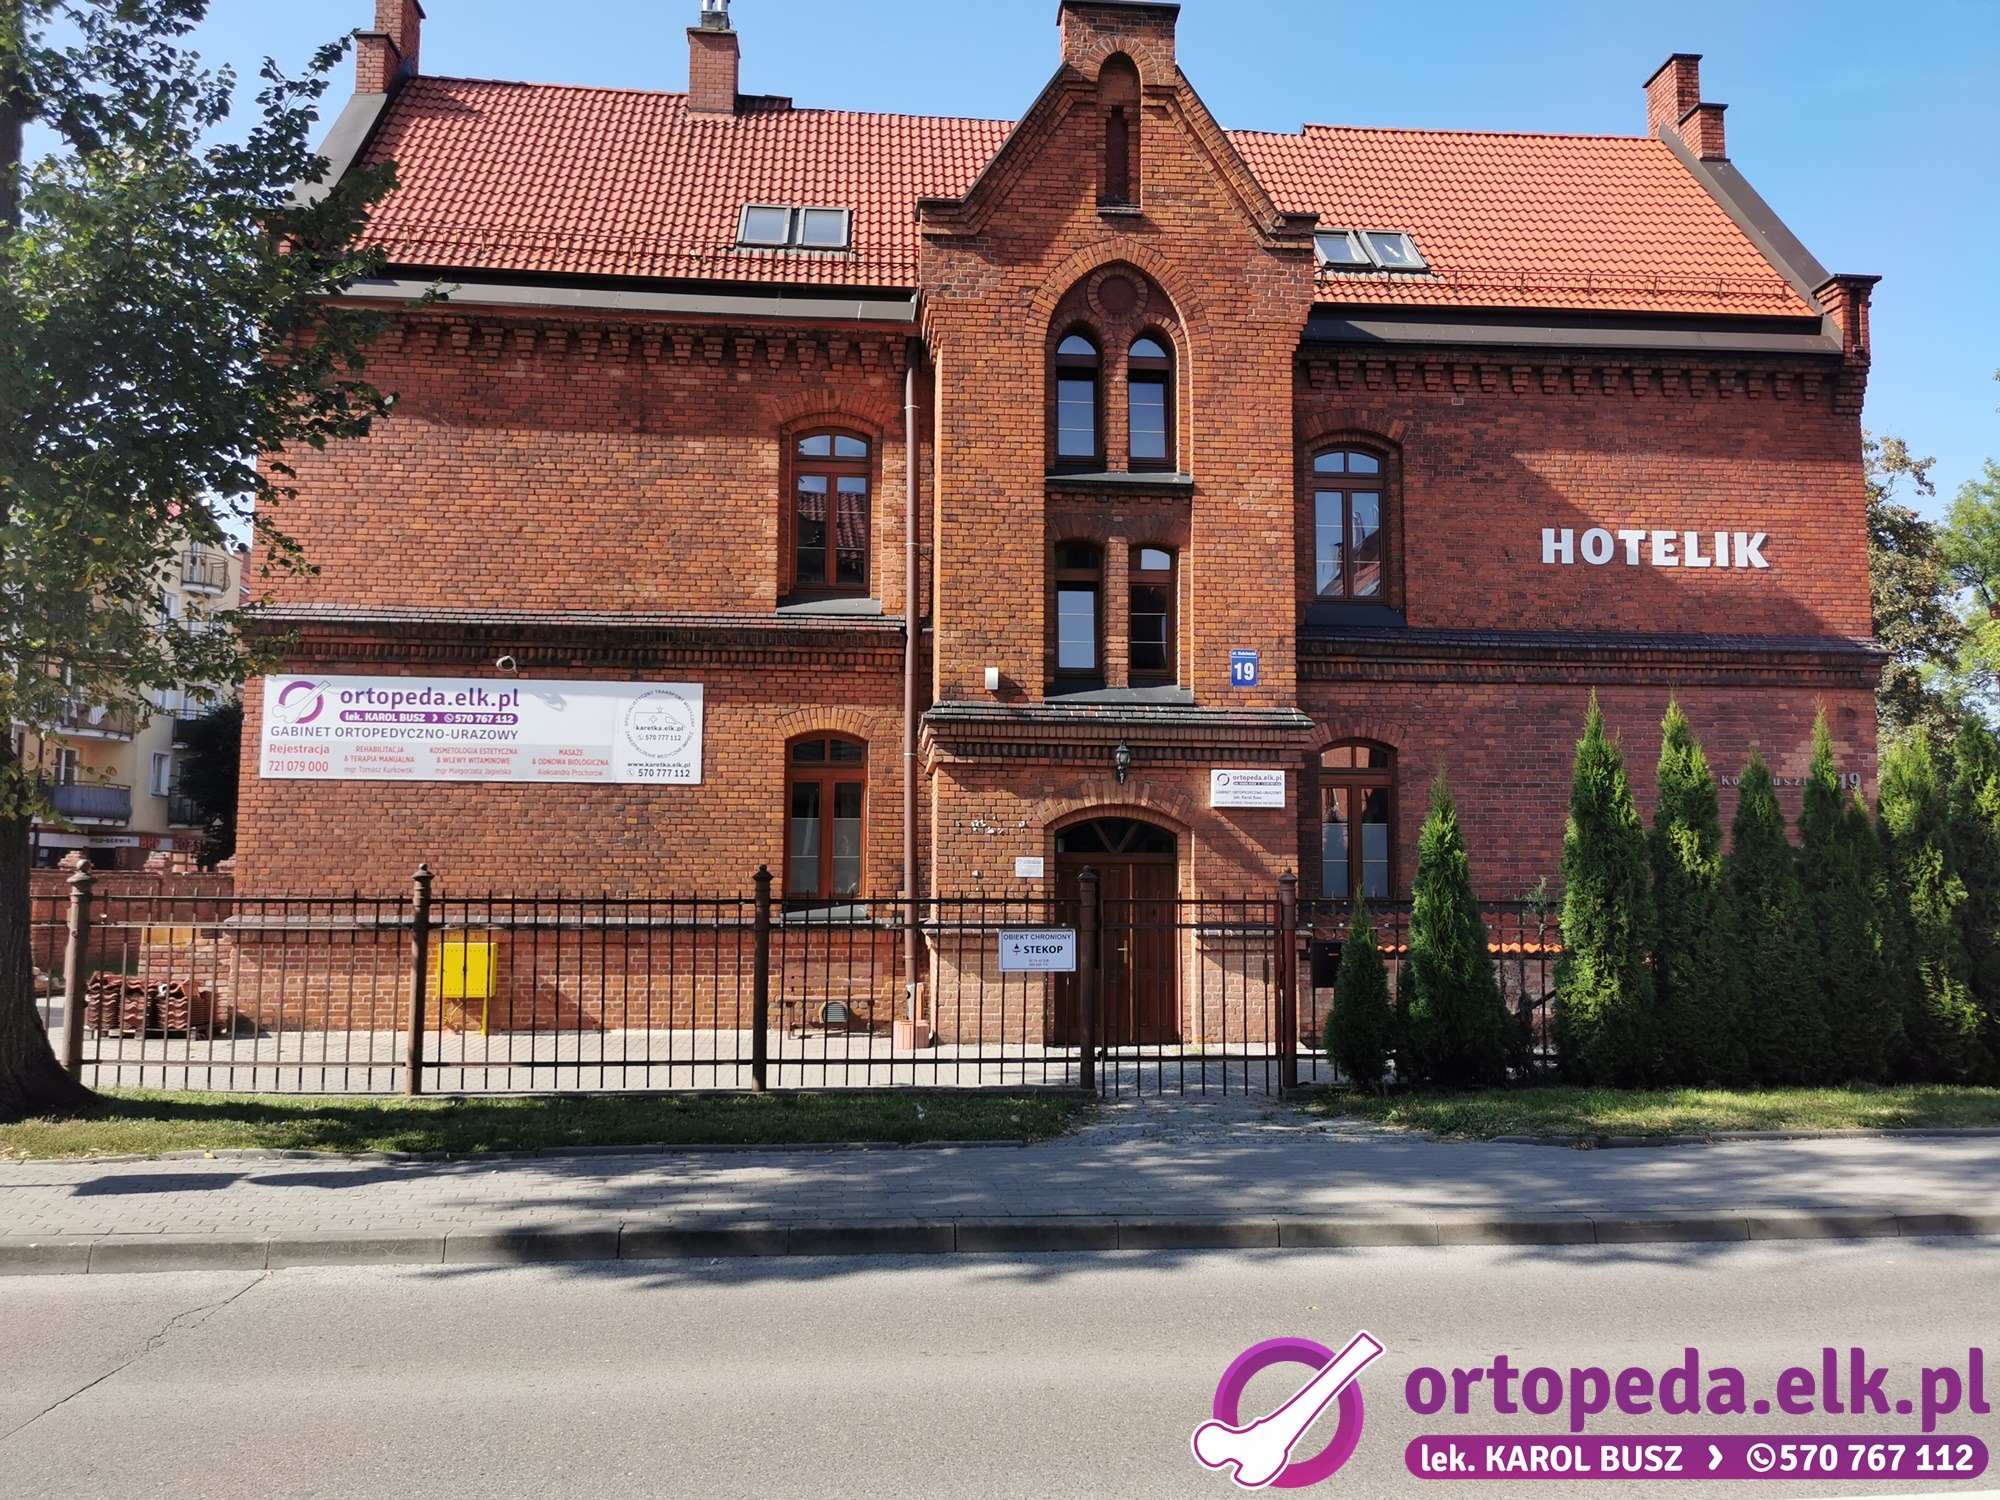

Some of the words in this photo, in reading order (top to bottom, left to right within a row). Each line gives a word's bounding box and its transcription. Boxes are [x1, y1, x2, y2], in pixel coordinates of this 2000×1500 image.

[1542, 527, 1770, 568] HOTELIK
[1234, 662, 1254, 680] 19
[340, 687, 520, 711] ortopeda.elk.pl
[345, 712, 363, 721] lek.
[365, 713, 398, 722] KAROL
[400, 714, 426, 722] BUSZ
[455, 714, 474, 723] 570
[476, 714, 495, 723] 767
[496, 715, 514, 723] 112
[271, 726, 331, 737] GABINET
[335, 726, 518, 740] ORTOPEDYCZNO-URAZOWY
[269, 744, 330, 755] Rejestracja
[430, 747, 478, 755] KOSMETOLOGIA
[269, 760, 284, 771] 721
[287, 760, 305, 772] 079
[308, 761, 329, 772] 000
[538, 758, 566, 766] ODNOWA
[638, 768, 655, 777] 570
[656, 769, 672, 777] 777
[674, 769, 690, 778] 112
[1232, 774, 1283, 782] ortopeda.elk.pl
[1023, 945, 1063, 953] STEKOP
